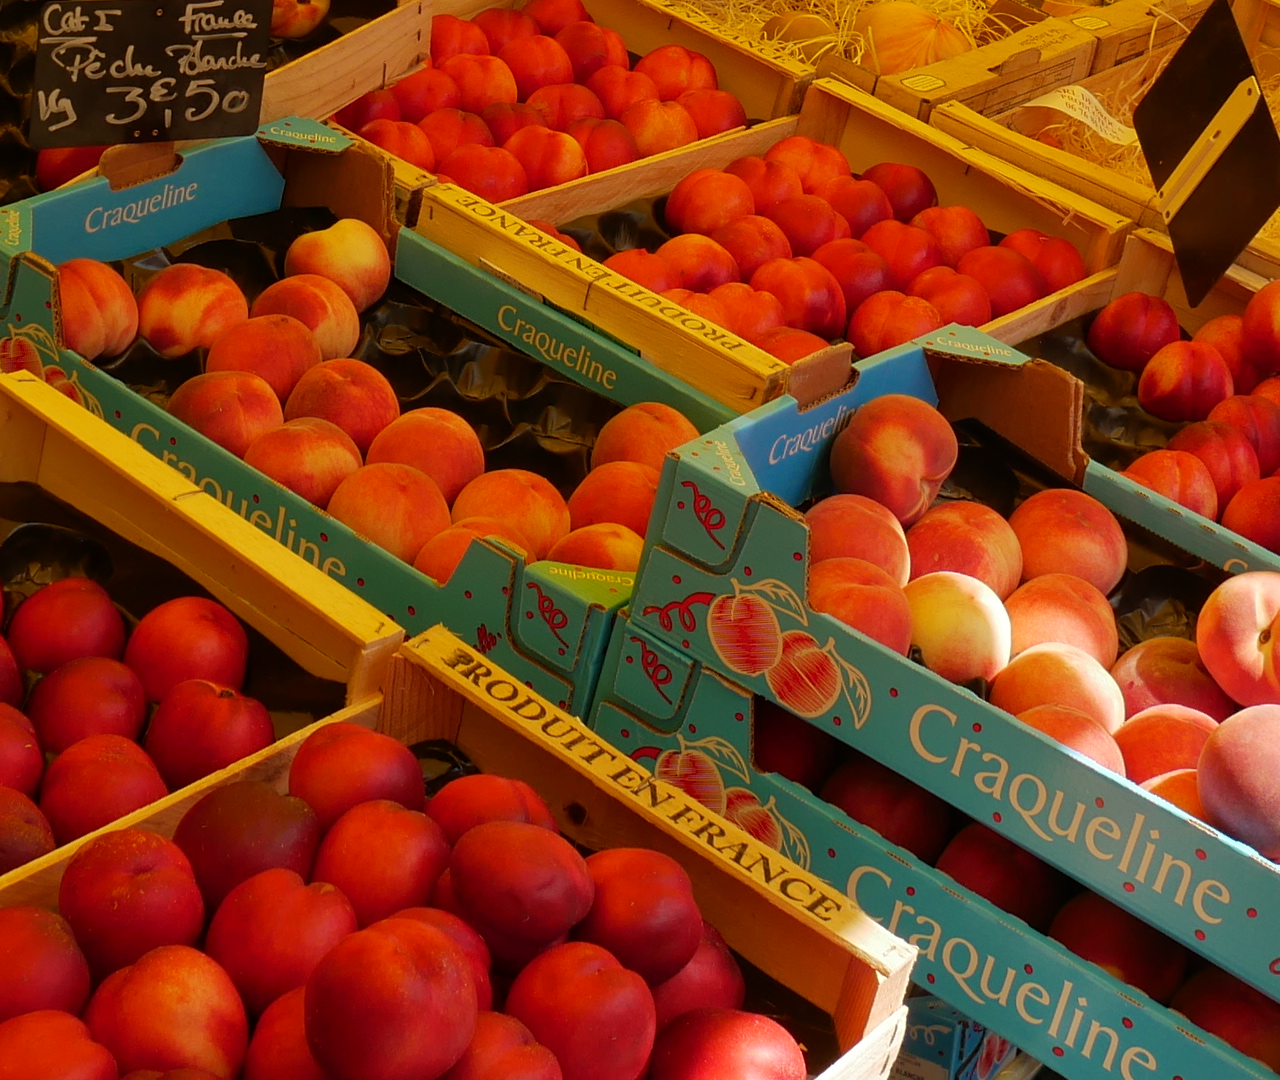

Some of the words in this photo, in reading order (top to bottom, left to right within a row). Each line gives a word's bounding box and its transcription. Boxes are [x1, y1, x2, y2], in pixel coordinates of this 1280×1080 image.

[43, 3, 90, 36] Cat
[178, 0, 258, 35] France
[165, 39, 268, 75] Blanche
[270, 125, 337, 144] Craqueline
[3, 208, 21, 247] Craqueline
[84, 181, 199, 234] Craqueline
[454, 194, 566, 258] FRANCE
[565, 253, 608, 281] EN
[605, 280, 748, 352] PRODUIT
[496, 304, 618, 390] Craqueline
[936, 336, 1013, 358] Craqueline
[715, 439, 746, 487] Craqueline
[548, 565, 635, 588] Craqueline
[442, 647, 616, 766] PRODUIT
[606, 762, 675, 809] EN
[667, 803, 842, 923] FRANCE
[908, 703, 1232, 926] Craqueline
[846, 865, 1159, 1080] Craqueline
